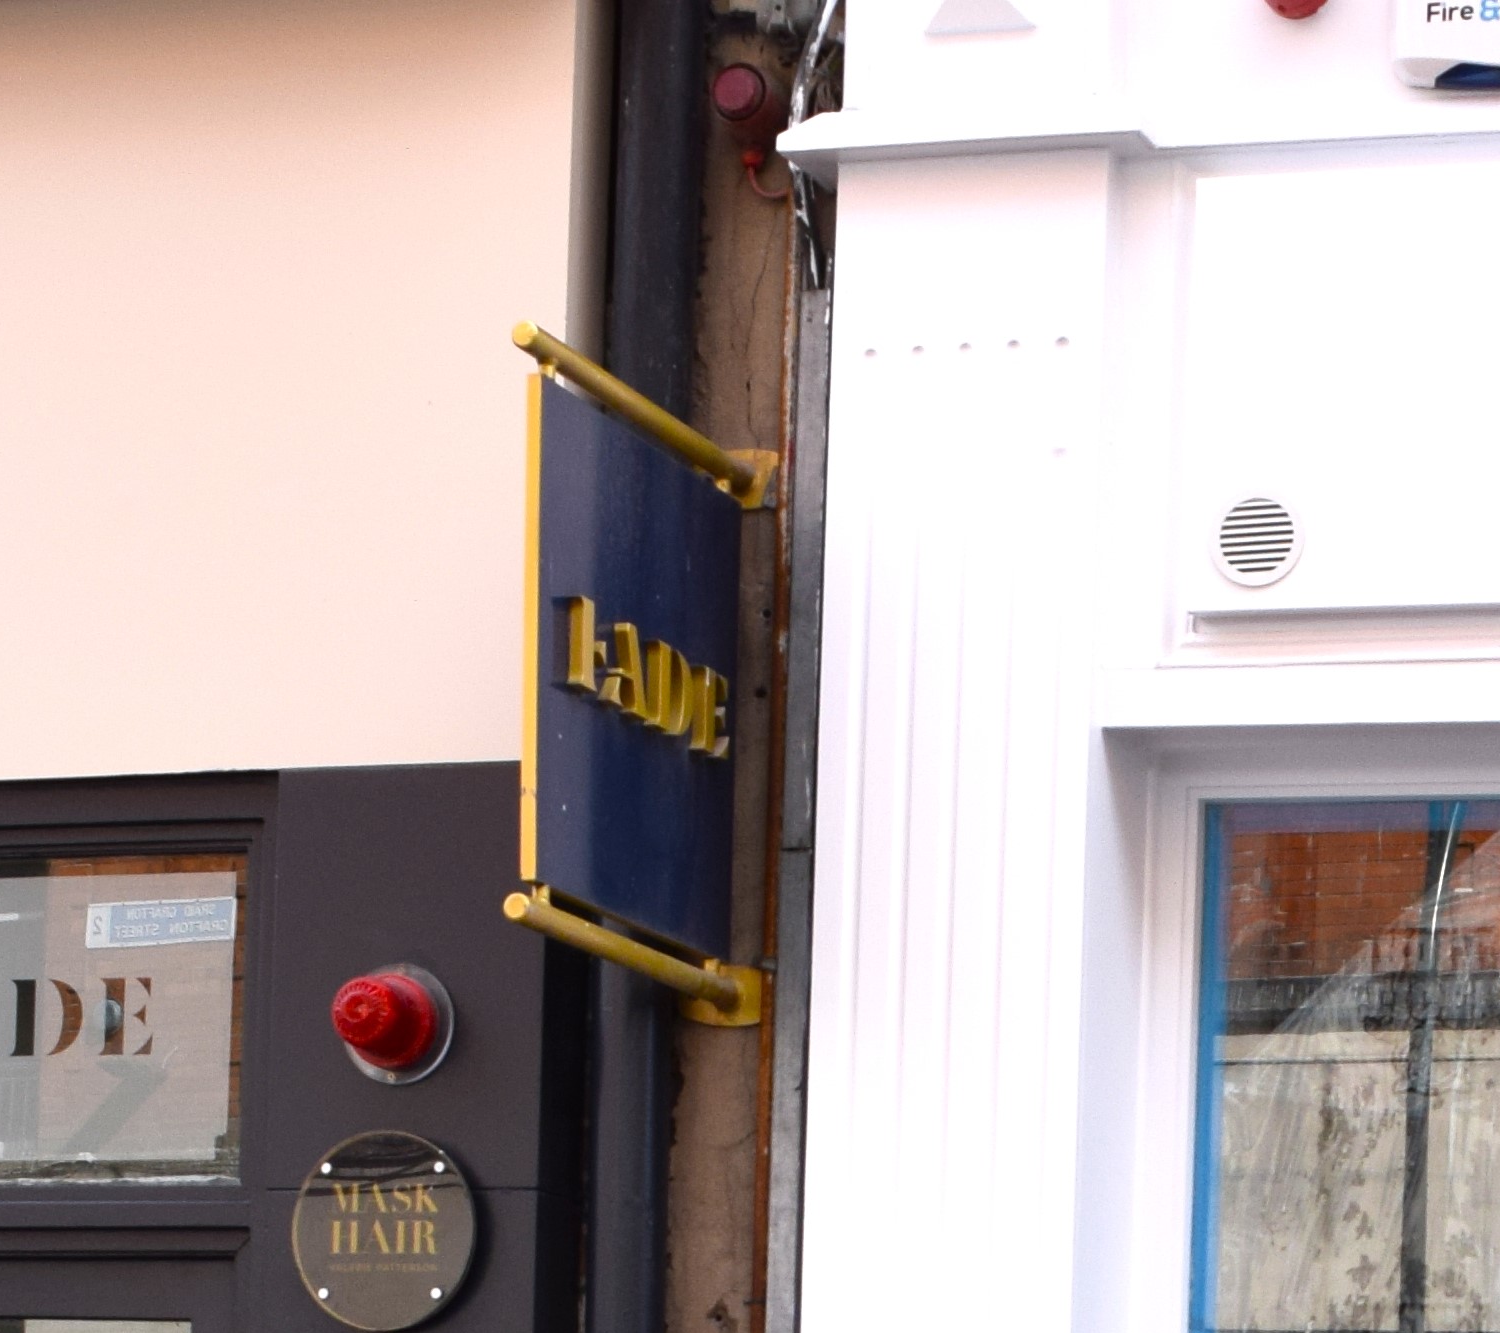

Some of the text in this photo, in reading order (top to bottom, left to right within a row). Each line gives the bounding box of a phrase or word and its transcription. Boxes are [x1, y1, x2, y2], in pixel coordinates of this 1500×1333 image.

[1427, 2, 1474, 22] Fire
[566, 595, 729, 759] FADE
[333, 1182, 439, 1214] MASK
[330, 1220, 438, 1256] HAIR
